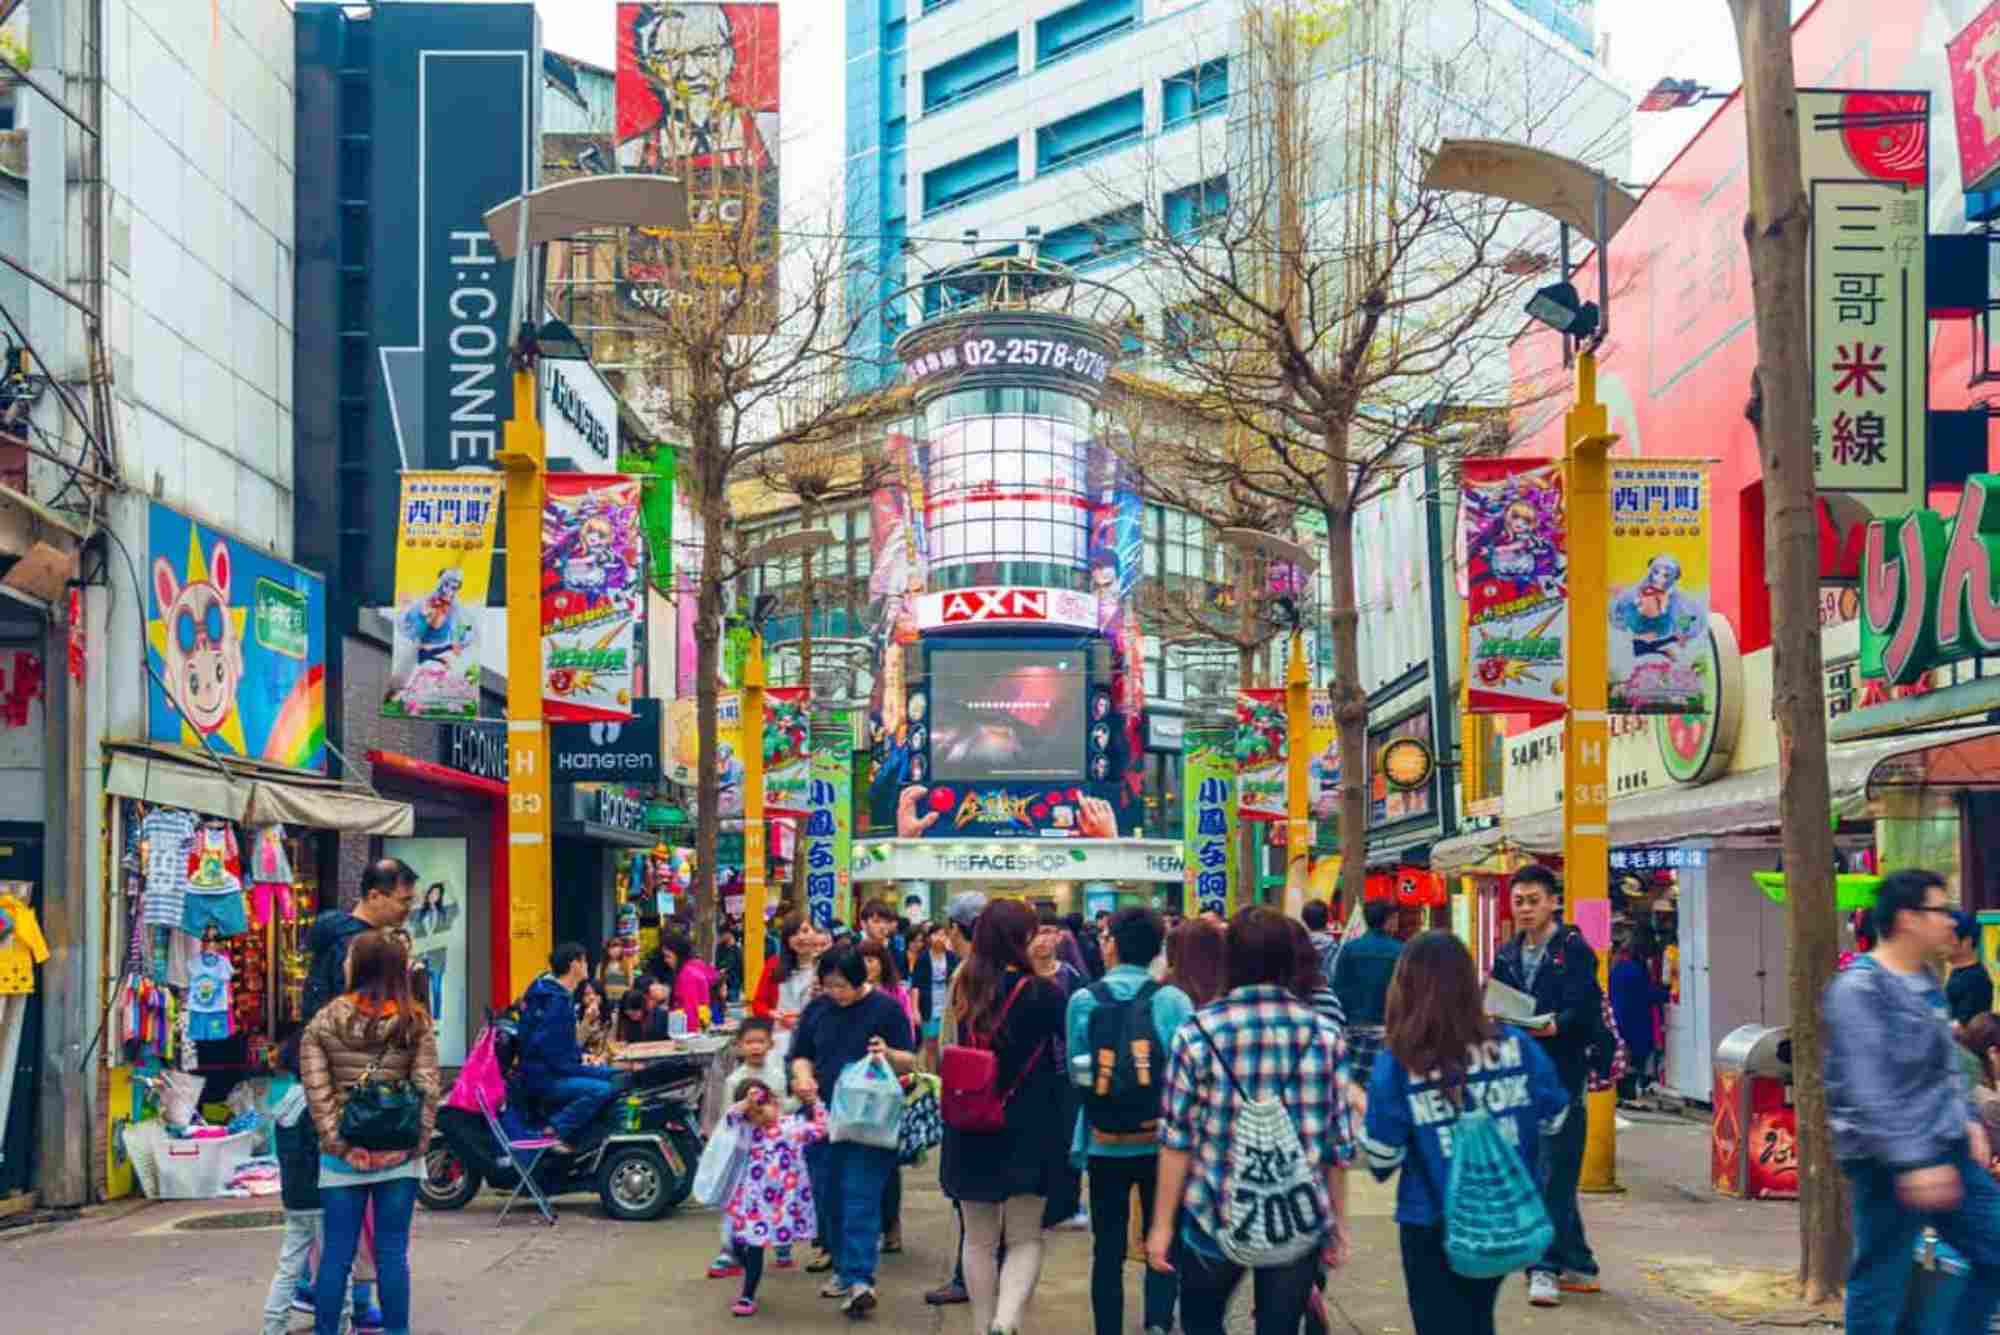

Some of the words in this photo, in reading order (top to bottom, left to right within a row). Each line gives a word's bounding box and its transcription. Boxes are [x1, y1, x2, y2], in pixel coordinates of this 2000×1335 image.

[1832, 205, 1887, 465] 三哥米線
[449, 231, 497, 472] H:CONNE
[407, 498, 491, 524] 西門町
[1614, 485, 1699, 512] 西門町
[944, 591, 1046, 620] AXN
[516, 751, 533, 775] H
[1233, 1183, 1322, 1244] 700
